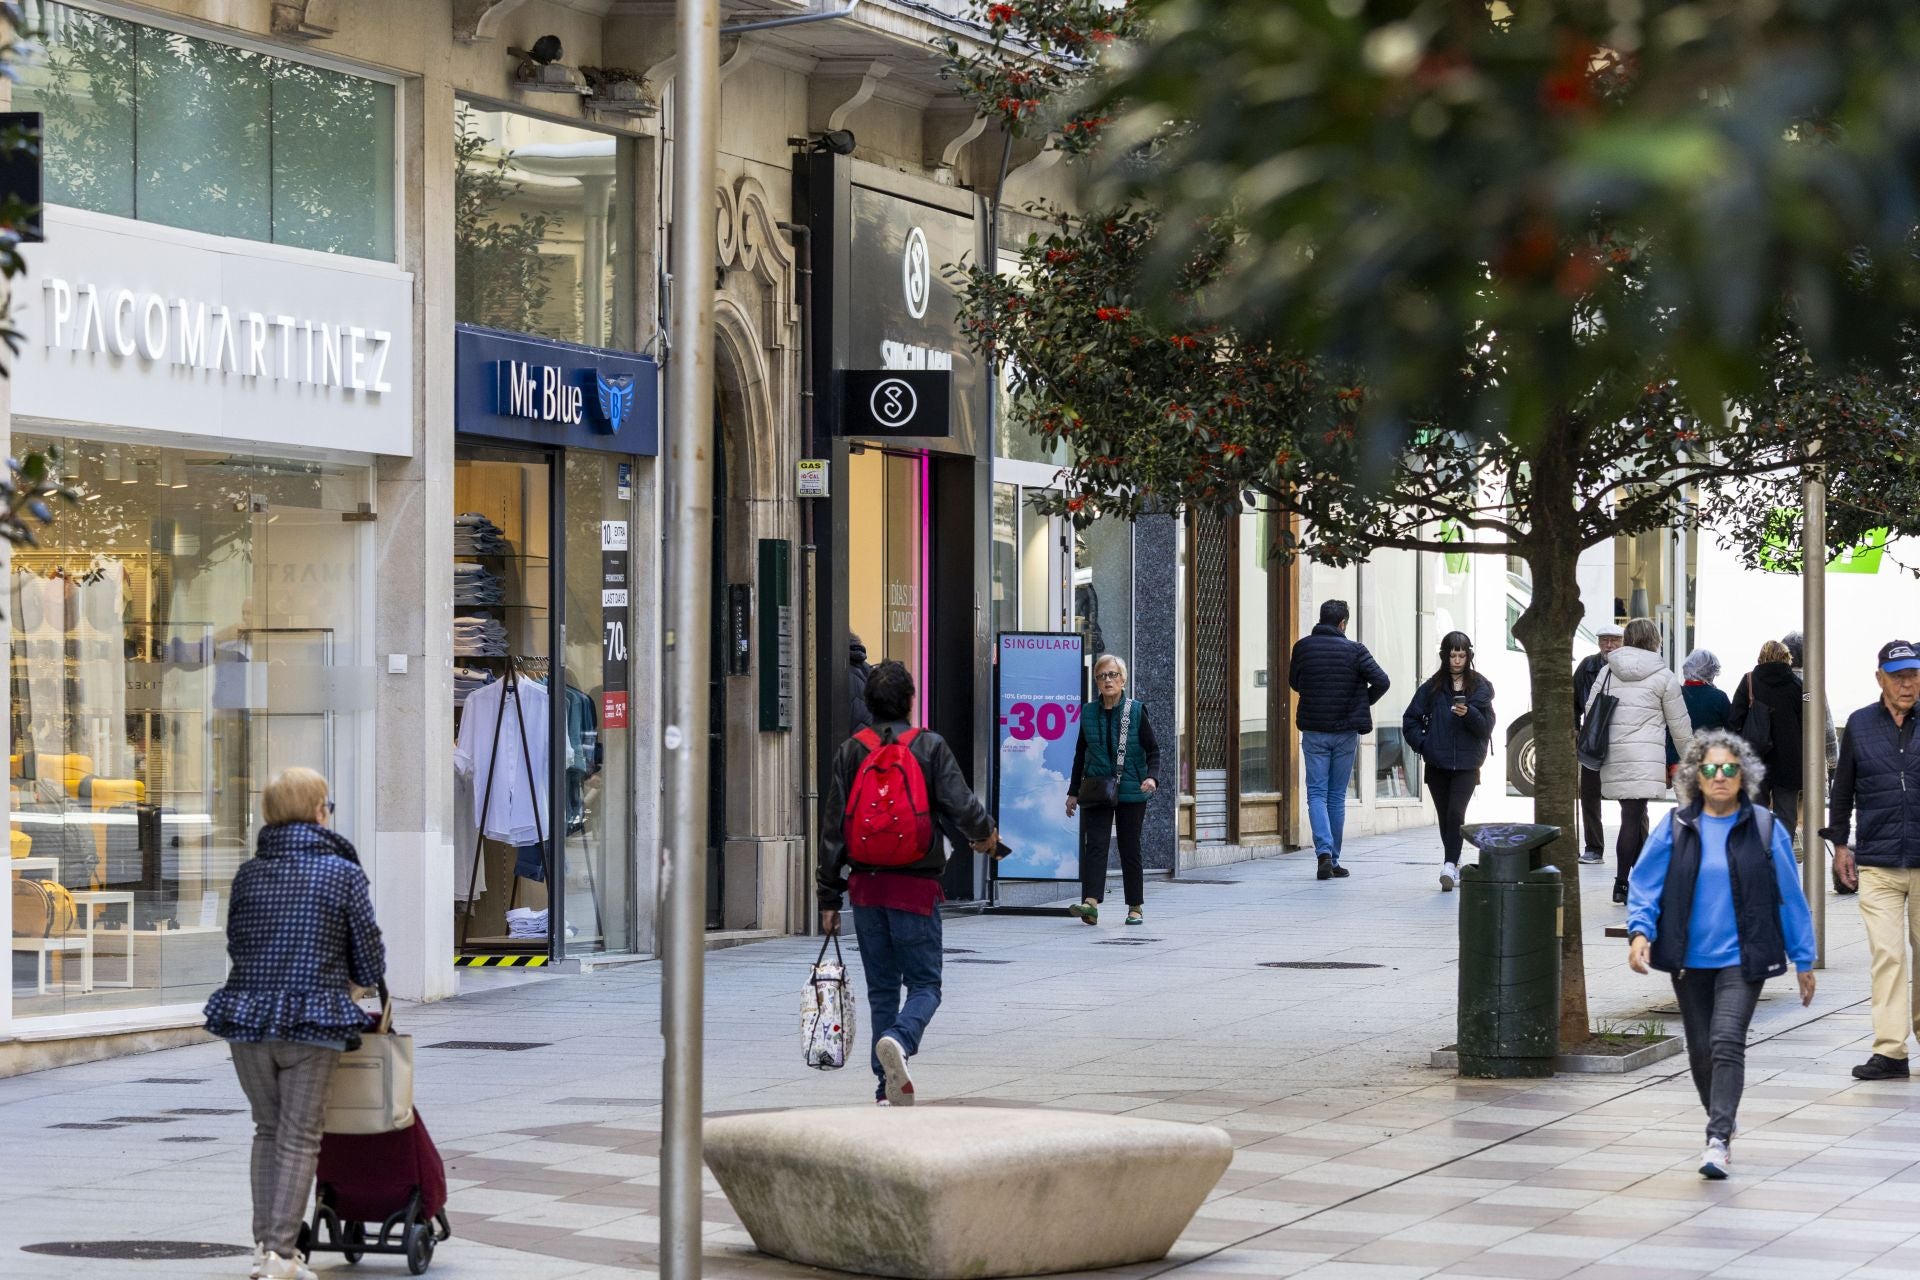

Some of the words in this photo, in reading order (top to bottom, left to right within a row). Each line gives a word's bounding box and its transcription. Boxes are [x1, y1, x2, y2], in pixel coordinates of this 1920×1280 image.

[510, 359, 538, 420] Mr.
[543, 365, 583, 425] Blue
[800, 462, 821, 470] GAS
[604, 592, 614, 605] LAST
[1004, 638, 1081, 650] SINGULARU
